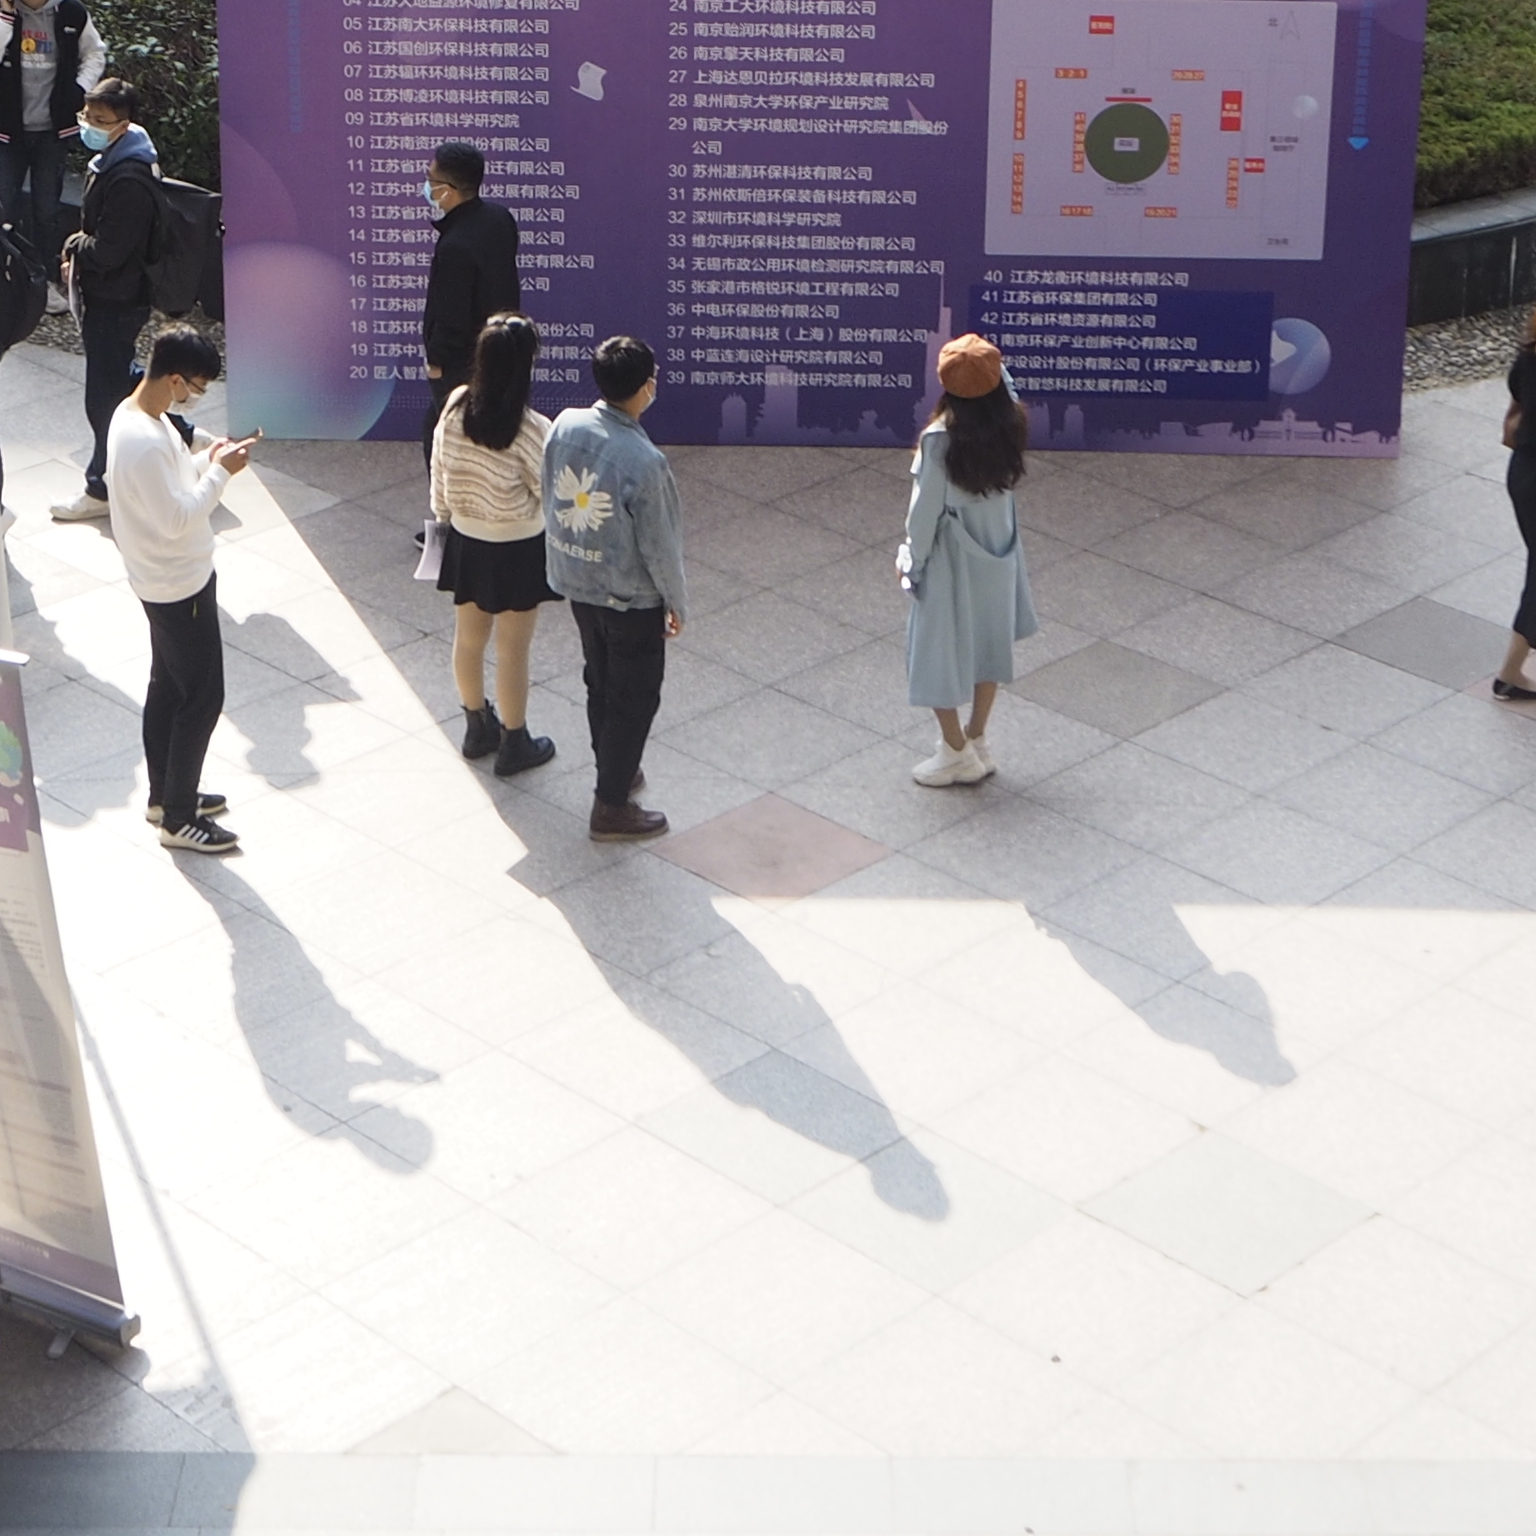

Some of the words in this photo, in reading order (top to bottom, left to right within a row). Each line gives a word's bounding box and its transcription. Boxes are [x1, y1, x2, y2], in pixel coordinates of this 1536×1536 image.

[343, 17, 362, 31] 05
[367, 16, 550, 34] 江苏南大环保科技有限公司
[669, 22, 688, 36] 25
[343, 41, 362, 55] 06
[367, 40, 550, 58] 江苏国创环保科技有限公司
[669, 46, 688, 60] 26
[693, 46, 845, 63] 南京擎天科技有限公司
[343, 65, 362, 78] 07
[368, 64, 550, 82] 江苏辐环环境科技有限公司
[668, 70, 687, 84] 27
[693, 70, 935, 89] 上海达恩贝拉环境科技发展有限公司
[344, 88, 363, 102] 08
[368, 87, 550, 105] 江苏博凌环境科技有限公司
[668, 94, 688, 108] 28
[693, 93, 890, 111] 泉州南京大学环保产业研究院
[345, 112, 363, 126] 09
[369, 111, 520, 129] 江苏省环境科学研究院
[668, 117, 688, 131] 29
[692, 117, 949, 136] 南京大学环境规划设计研究院集团股份
[347, 136, 364, 149] 10
[691, 140, 723, 156] 公司
[347, 159, 364, 172] 11
[668, 164, 687, 177] 30
[692, 164, 873, 182] 苏州湛清环保科技有限公司
[348, 183, 365, 196] 12
[668, 187, 686, 201] 31
[692, 187, 917, 205] 苏州依斯倍环保装备科技有限公司
[348, 206, 365, 219] 13
[668, 211, 687, 224] 32
[691, 210, 843, 227] 深圳市环境科学研究院
[348, 229, 365, 242] 14
[668, 234, 686, 248] 33
[691, 234, 916, 252] 维尔利环保科技集团股份有限公司
[349, 252, 366, 265] 15
[668, 257, 686, 271] 34
[691, 257, 945, 275] 无锡市政公用环境检测研究院有限公司
[349, 275, 367, 288] 16
[983, 270, 1003, 284] 40
[1009, 269, 1189, 287] 江苏龙衡环境科技有限公司
[667, 280, 686, 294] 35
[691, 280, 900, 298] 张家港市格锐环境工程有限公司
[349, 298, 367, 311] 17
[981, 290, 998, 303] 41
[1002, 290, 1158, 307] 江苏省环保集团有限公司
[667, 303, 686, 316] 36
[691, 302, 840, 320] 中电环保股份有限公司
[981, 312, 998, 325] 42
[1001, 311, 1156, 329] 江苏省环境资源有限公司
[349, 321, 368, 334] 18
[667, 326, 685, 339] 37
[691, 325, 928, 343] 中海环境科技（上海）股份有限公司
[350, 344, 368, 357] 19
[1000, 333, 1197, 351] 南京环保产业创新中心有限公司
[667, 349, 685, 362] 38
[690, 348, 883, 365] 中蓝连海设计研究院有限公司
[349, 366, 368, 379] 20
[667, 371, 685, 385] 39
[690, 370, 912, 389] 南京师大环境科技研究院有限公司
